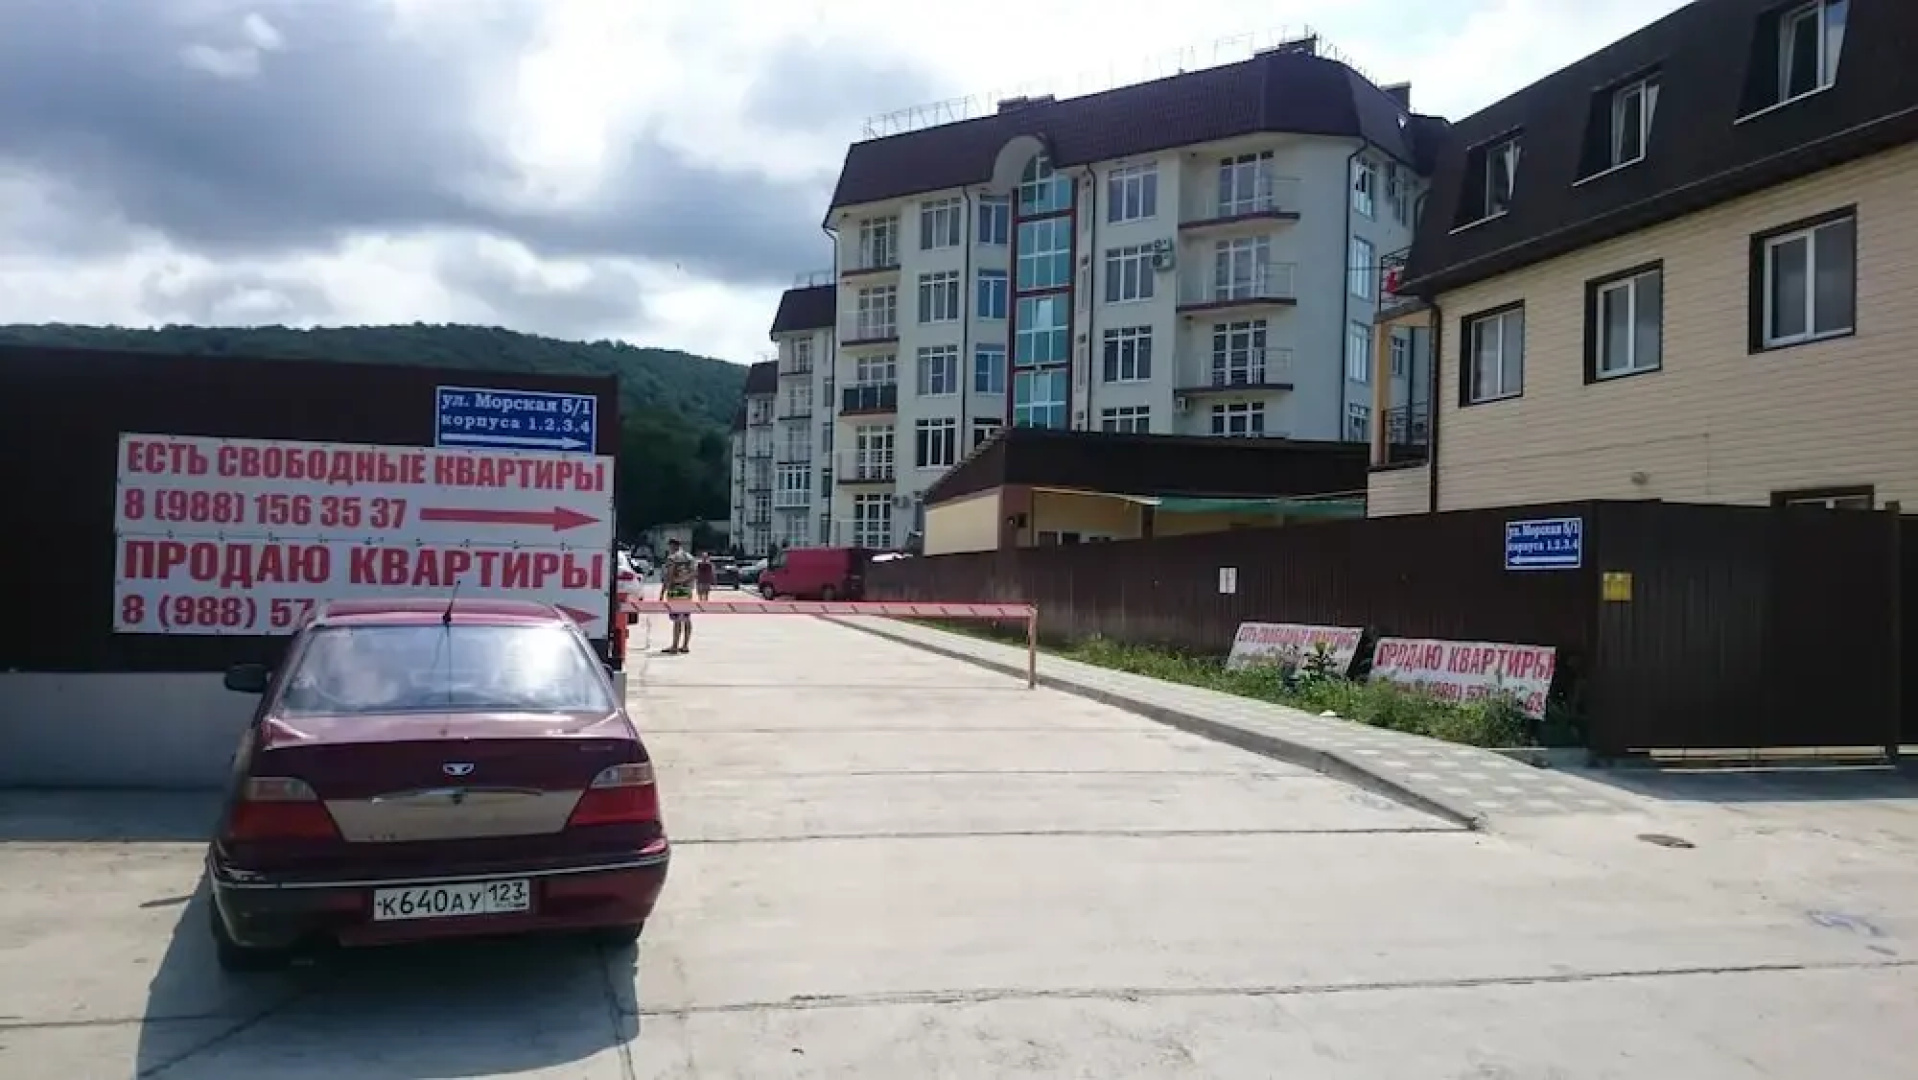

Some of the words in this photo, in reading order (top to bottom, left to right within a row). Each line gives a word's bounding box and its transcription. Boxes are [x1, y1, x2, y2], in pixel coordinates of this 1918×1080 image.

[442, 394, 469, 410] ул.
[475, 392, 557, 413] Морская
[562, 399, 590, 417] 5/1
[441, 414, 521, 430] корпуса
[528, 417, 590, 433] 1.2.3.4
[127, 441, 209, 475] ЕСТЬ
[217, 446, 426, 485] СВОБОДНЫЕ
[434, 456, 604, 491] КВАРТИРЫ
[124, 488, 145, 520] 8
[154, 489, 245, 523] (988)
[254, 494, 312, 526] 156
[320, 495, 362, 527] 35
[370, 498, 407, 529] 37
[124, 540, 331, 589] ПРОДАЮ
[350, 546, 603, 589] КВАРТИРЫ
[122, 594, 145, 624] 8
[158, 594, 257, 628] (988)
[270, 598, 315, 628] 57
[1376, 642, 1443, 672] ПРОДАЮ
[1448, 646, 1557, 680] КВАРТИРЫ
[383, 889, 481, 915] К640АУ
[488, 882, 523, 900] 123
